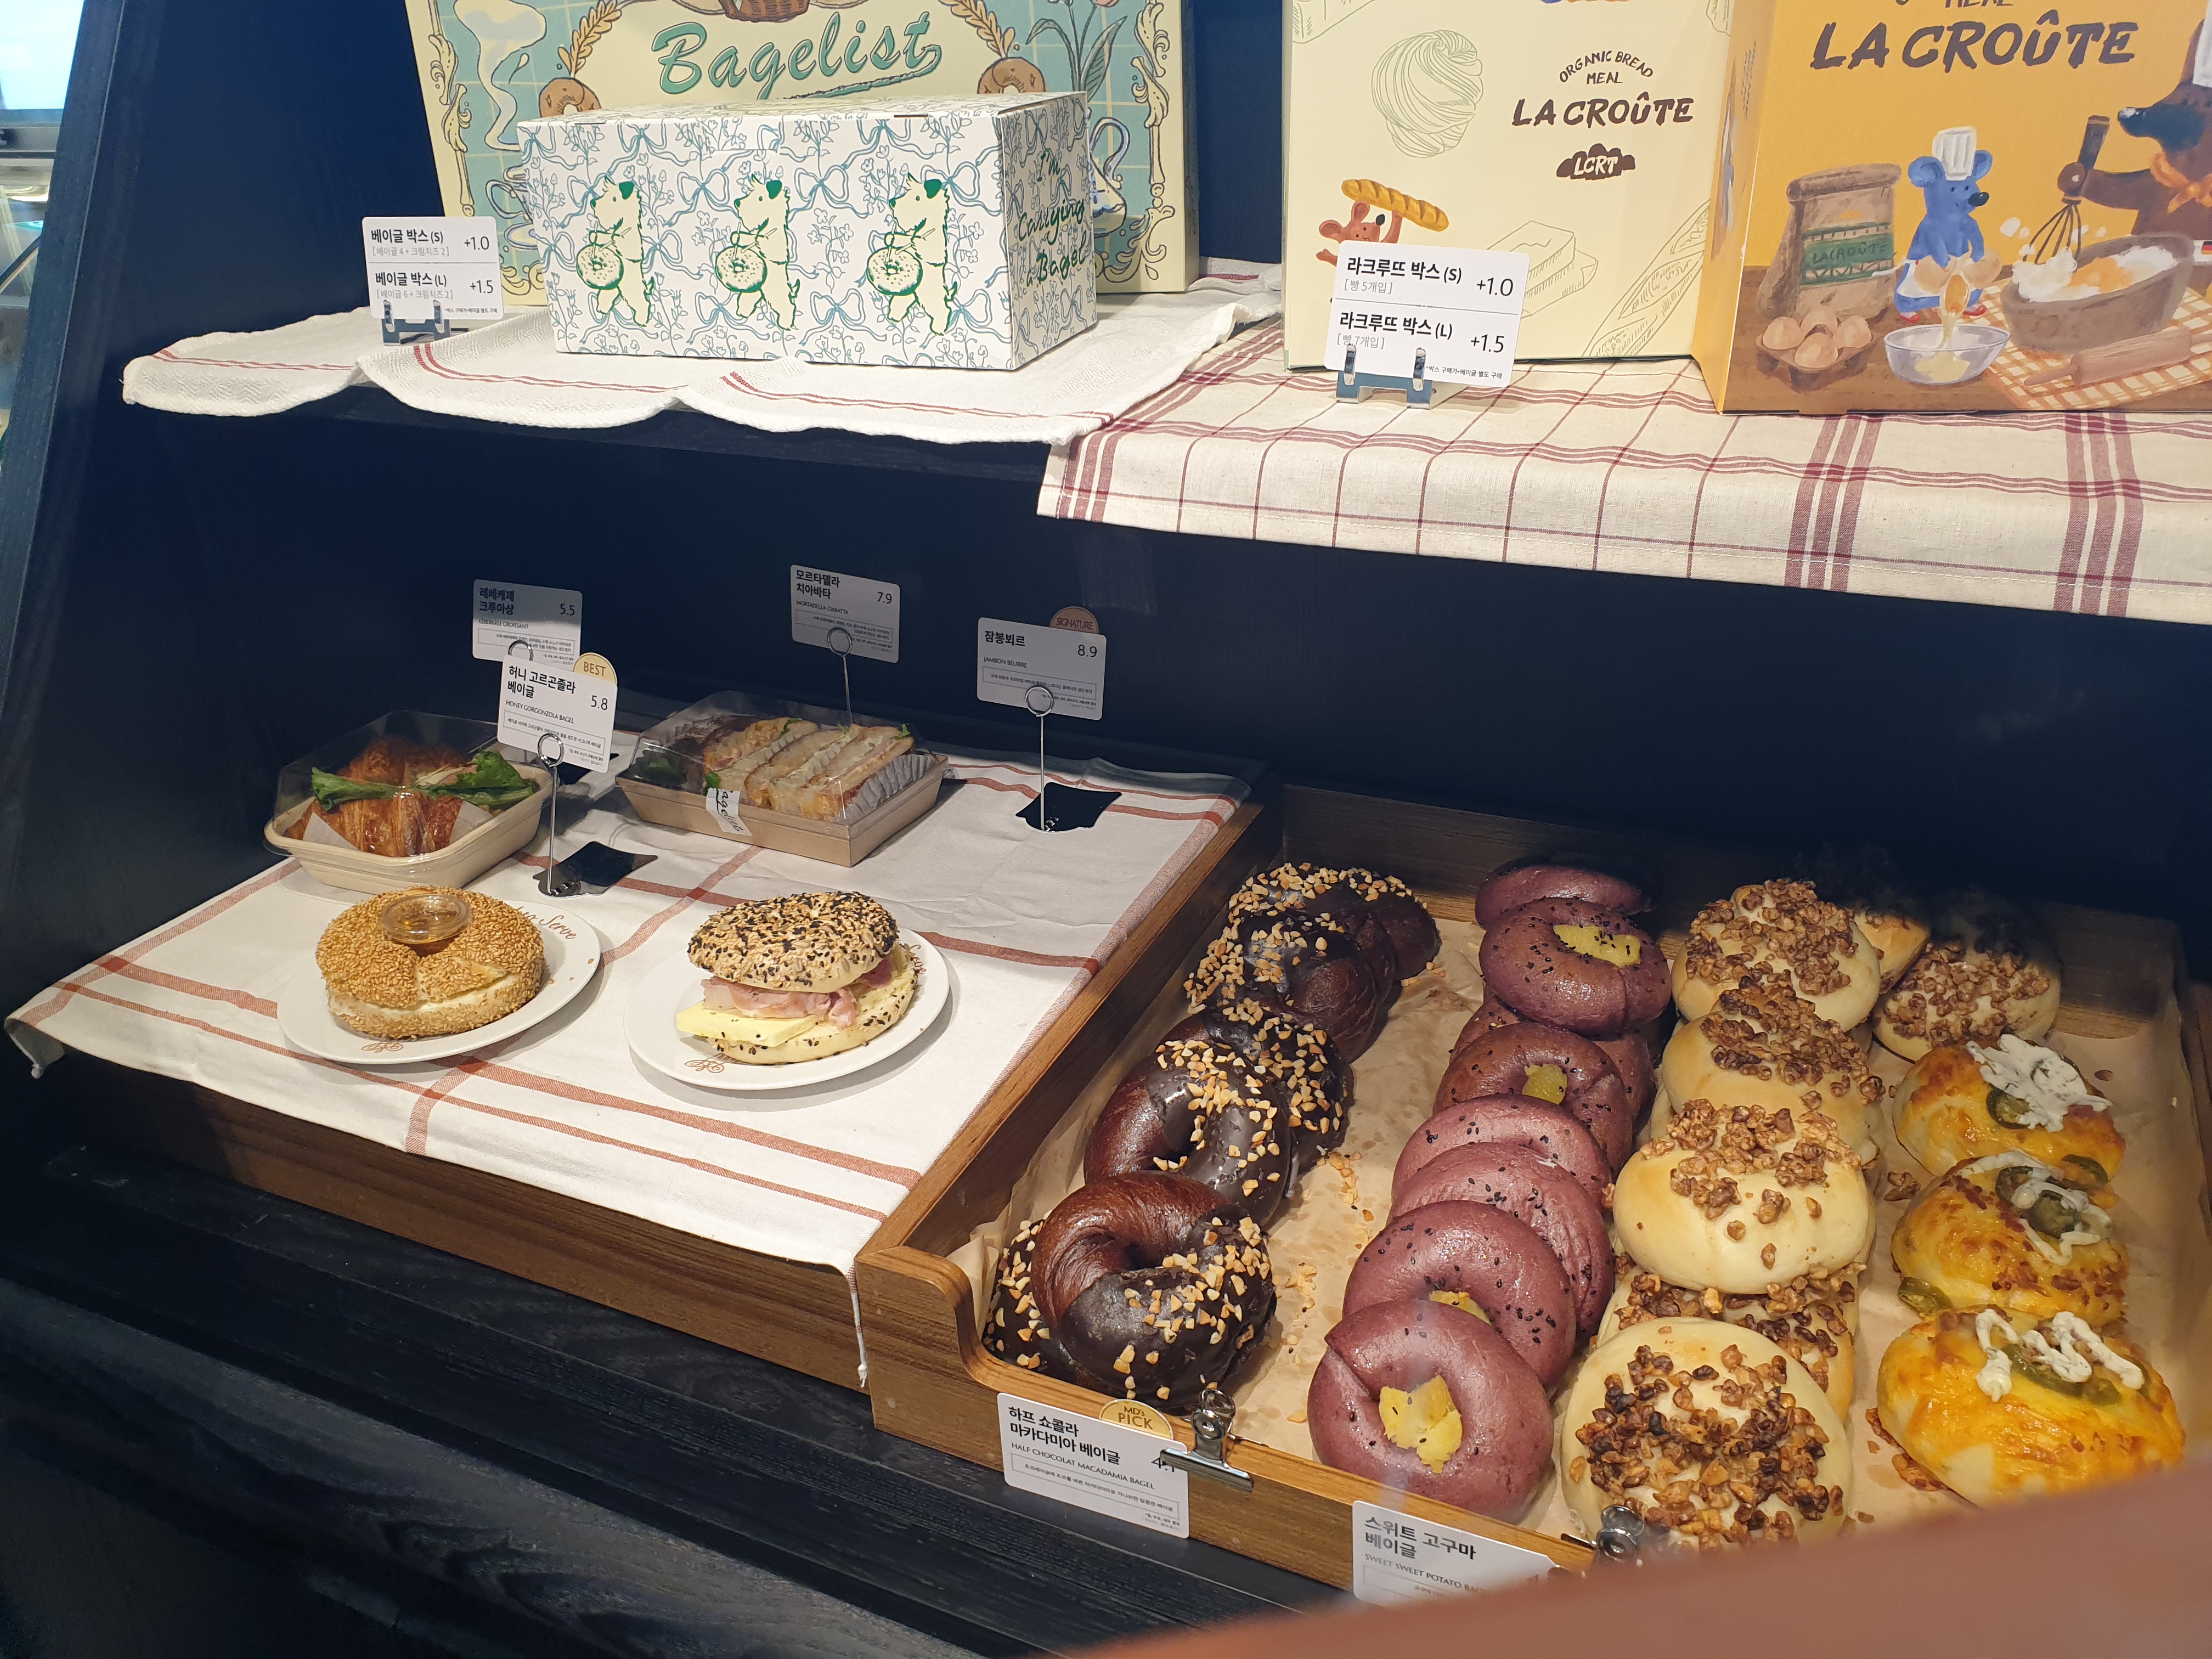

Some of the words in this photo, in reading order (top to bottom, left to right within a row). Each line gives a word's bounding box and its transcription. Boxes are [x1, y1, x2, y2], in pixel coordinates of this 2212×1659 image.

[1810, 21, 1889, 70] LA
[1901, 9, 2139, 74] CROÛTE
[651, 11, 942, 100] Bagelist
[1559, 50, 1612, 83] ORGANIC
[1615, 51, 1654, 77] BREAD
[1587, 72, 1623, 84] MEAL
[1511, 99, 1556, 127] LA
[1564, 91, 1694, 129] CROÛTE
[1573, 155, 1618, 175] LCRT
[371, 229, 403, 244] 베이글
[407, 229, 428, 243] 박스
[464, 236, 489, 250] +1.0
[1035, 230, 1086, 281] Bagel
[1347, 256, 1406, 277] 라크루뜨
[1410, 261, 1440, 280] 박스
[375, 272, 407, 286] 베이글
[411, 272, 432, 286] 박스
[470, 280, 493, 294] +1.5
[1476, 277, 1514, 296] +1.0
[1340, 312, 1398, 332] 라크루뜨
[1402, 317, 1431, 336] 박스
[1470, 334, 1505, 353] +1.5
[796, 569, 840, 588] 모르타델라
[796, 583, 831, 599] 치아바타
[877, 591, 892, 604] 7.9
[479, 601, 514, 615] 크루아상
[560, 603, 575, 616] 5.5
[1056, 617, 1093, 630] SIGNATURE
[985, 630, 1025, 647] 잠봉뵈르
[1077, 644, 1097, 658] 8.9
[583, 662, 606, 676] BEST
[984, 656, 1006, 665] JAMBON
[1007, 660, 1027, 668] BEURRE
[507, 680, 534, 698] 베이글
[509, 665, 527, 681] 허니
[529, 671, 576, 694] 고르곤졸라
[506, 700, 523, 709] HONEY
[524, 705, 558, 719] GORGONZOLA
[560, 715, 574, 724] BAGEL
[591, 695, 608, 710] 5.8
[539, 915, 577, 939] Serve
[1124, 1406, 1145, 1416] MD's
[1008, 1406, 1036, 1424] 하프
[1039, 1415, 1079, 1437] 쇼콜라
[1118, 1412, 1153, 1430] PICK
[1010, 1422, 1077, 1453] 마카다미아
[1079, 1441, 1121, 1465] 베이글
[1012, 1442, 1030, 1452] HALF
[1032, 1448, 1075, 1466] CHOCOLAT
[1078, 1462, 1128, 1482] MACADAMIA
[1130, 1477, 1155, 1489] BAGEL
[1151, 1457, 1175, 1472] 4.
[1364, 1516, 1417, 1542] 스위트
[1422, 1532, 1476, 1560] 고구마
[1365, 1532, 1417, 1560] 베이글
[1364, 1553, 1393, 1567] SWEET
[1395, 1562, 1424, 1577] SWEET
[1426, 1572, 1462, 1589] POTATO
